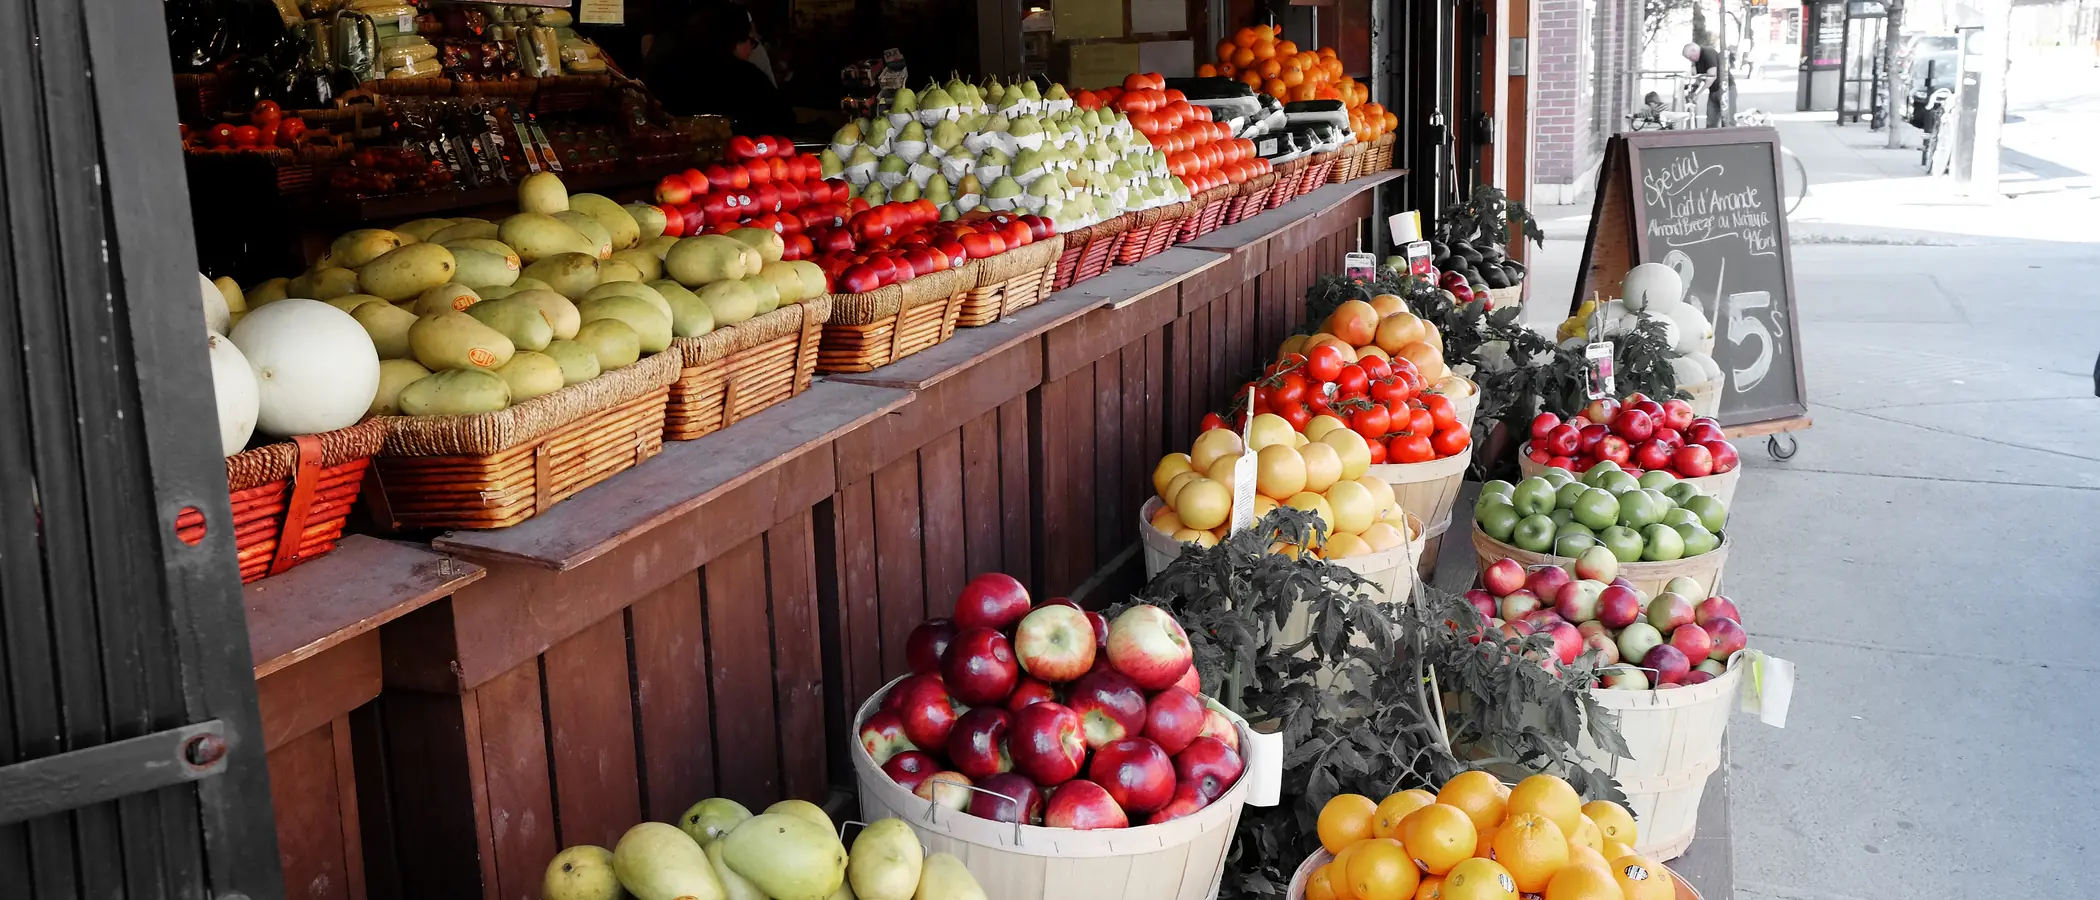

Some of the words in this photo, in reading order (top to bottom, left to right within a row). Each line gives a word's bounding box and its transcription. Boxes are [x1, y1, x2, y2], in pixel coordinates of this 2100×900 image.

[1644, 151, 1699, 208] Spécial
[1668, 190, 1695, 219] Lait
[1697, 186, 1761, 214] d'Amande
